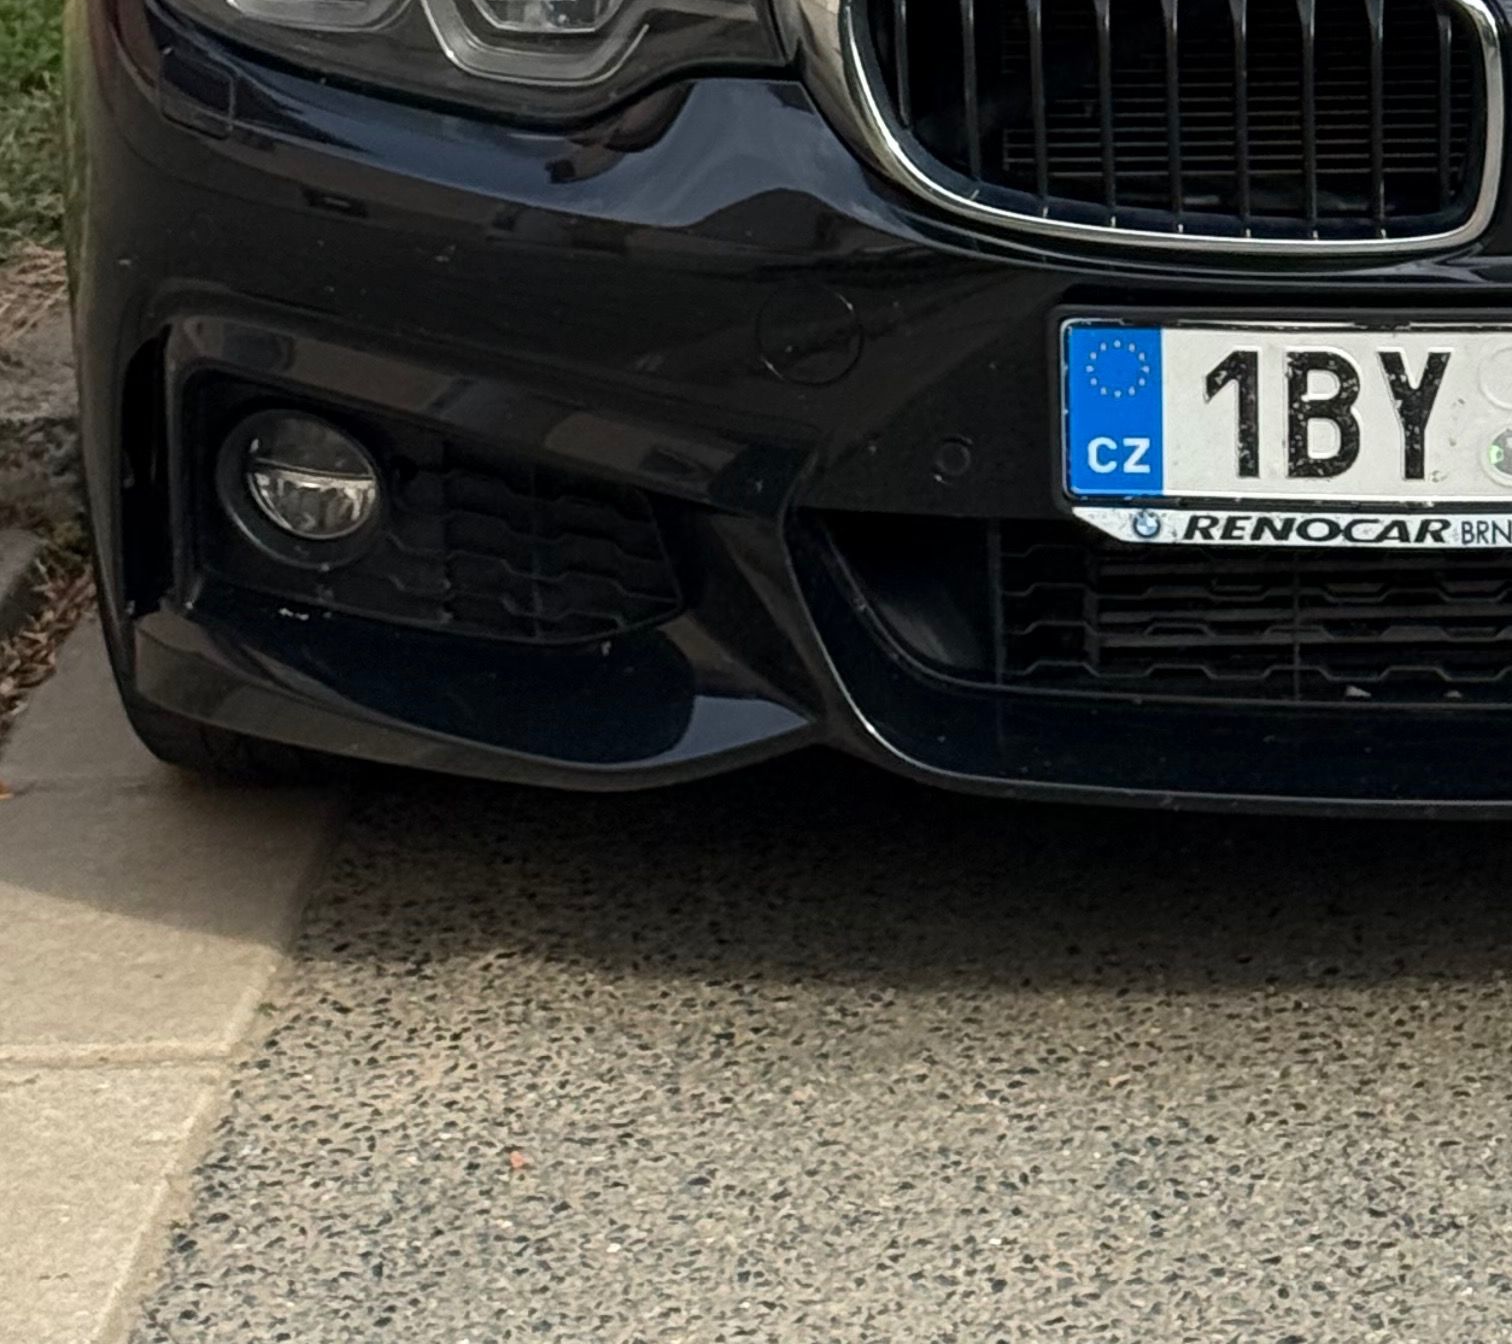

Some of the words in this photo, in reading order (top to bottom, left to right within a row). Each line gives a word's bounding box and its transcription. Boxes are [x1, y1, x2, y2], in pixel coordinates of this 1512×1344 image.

[1203, 349, 1452, 480] 1BY
[1087, 436, 1150, 474] CZ
[1182, 514, 1451, 543] RENOCAR
